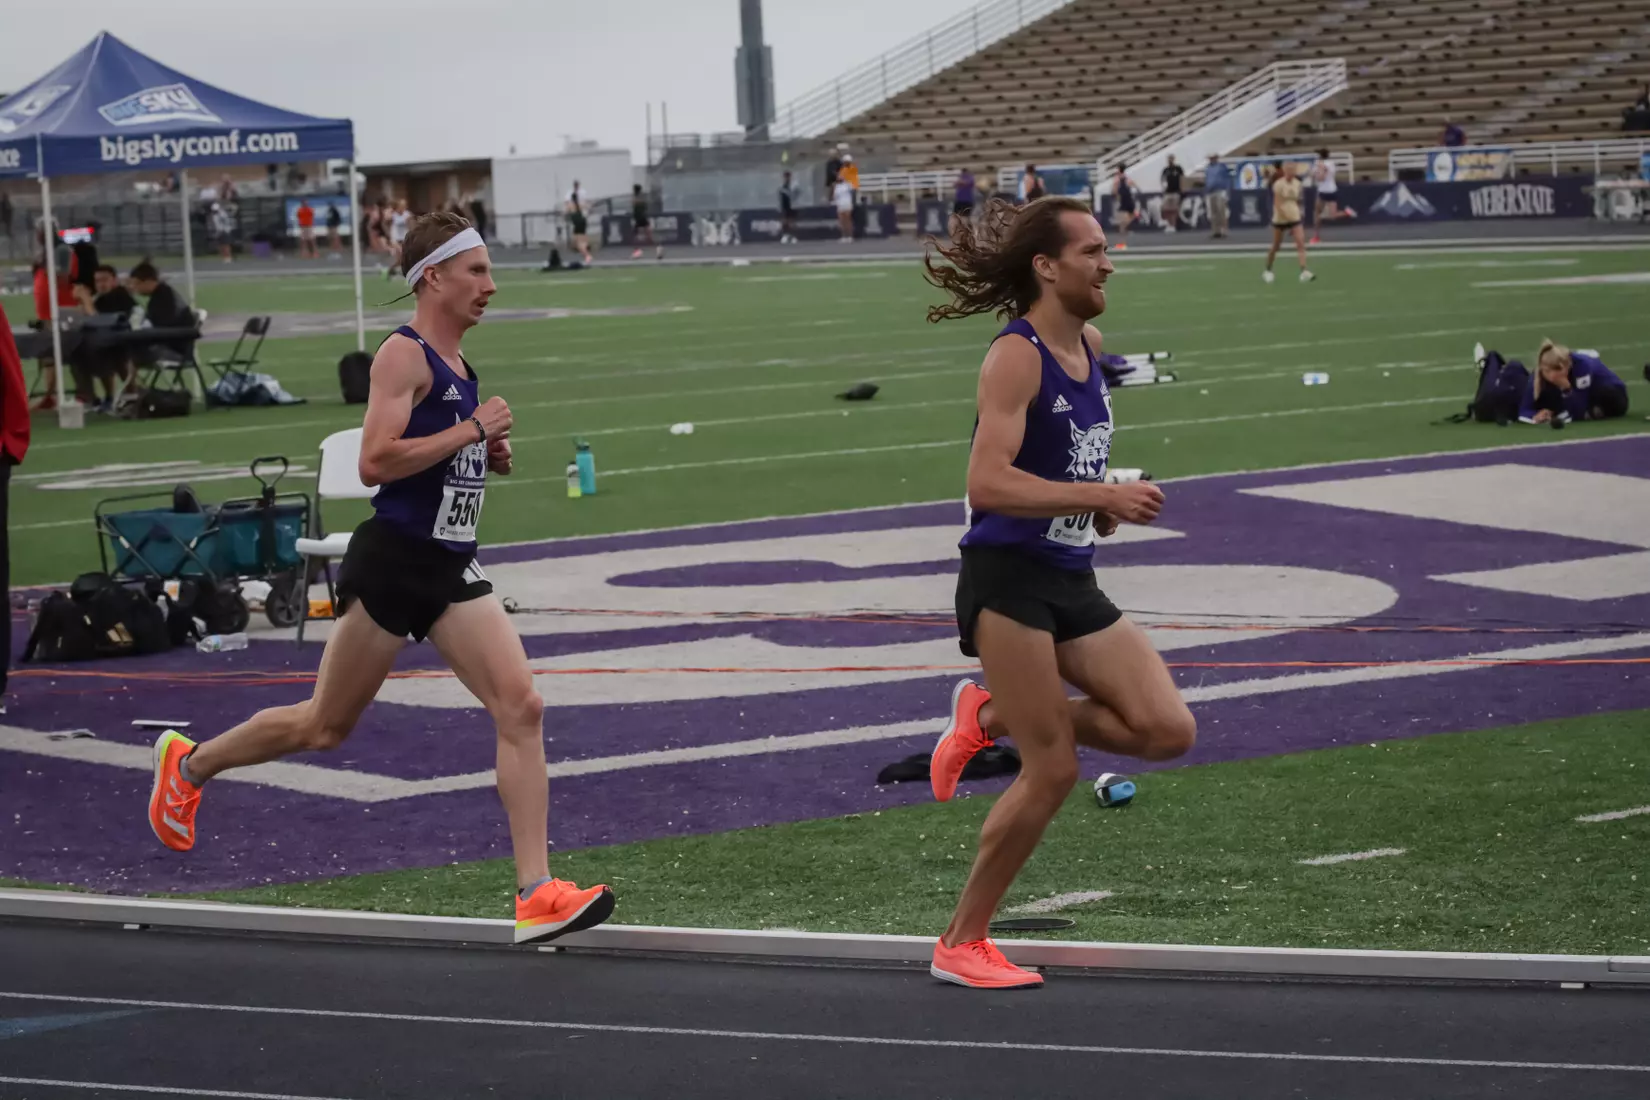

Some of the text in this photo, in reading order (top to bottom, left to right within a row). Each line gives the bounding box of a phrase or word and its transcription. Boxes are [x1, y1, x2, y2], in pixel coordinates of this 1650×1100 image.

[100, 131, 298, 164] bigskyconf.com
[1052, 405, 1073, 414] adidas
[447, 490, 482, 527] 550
